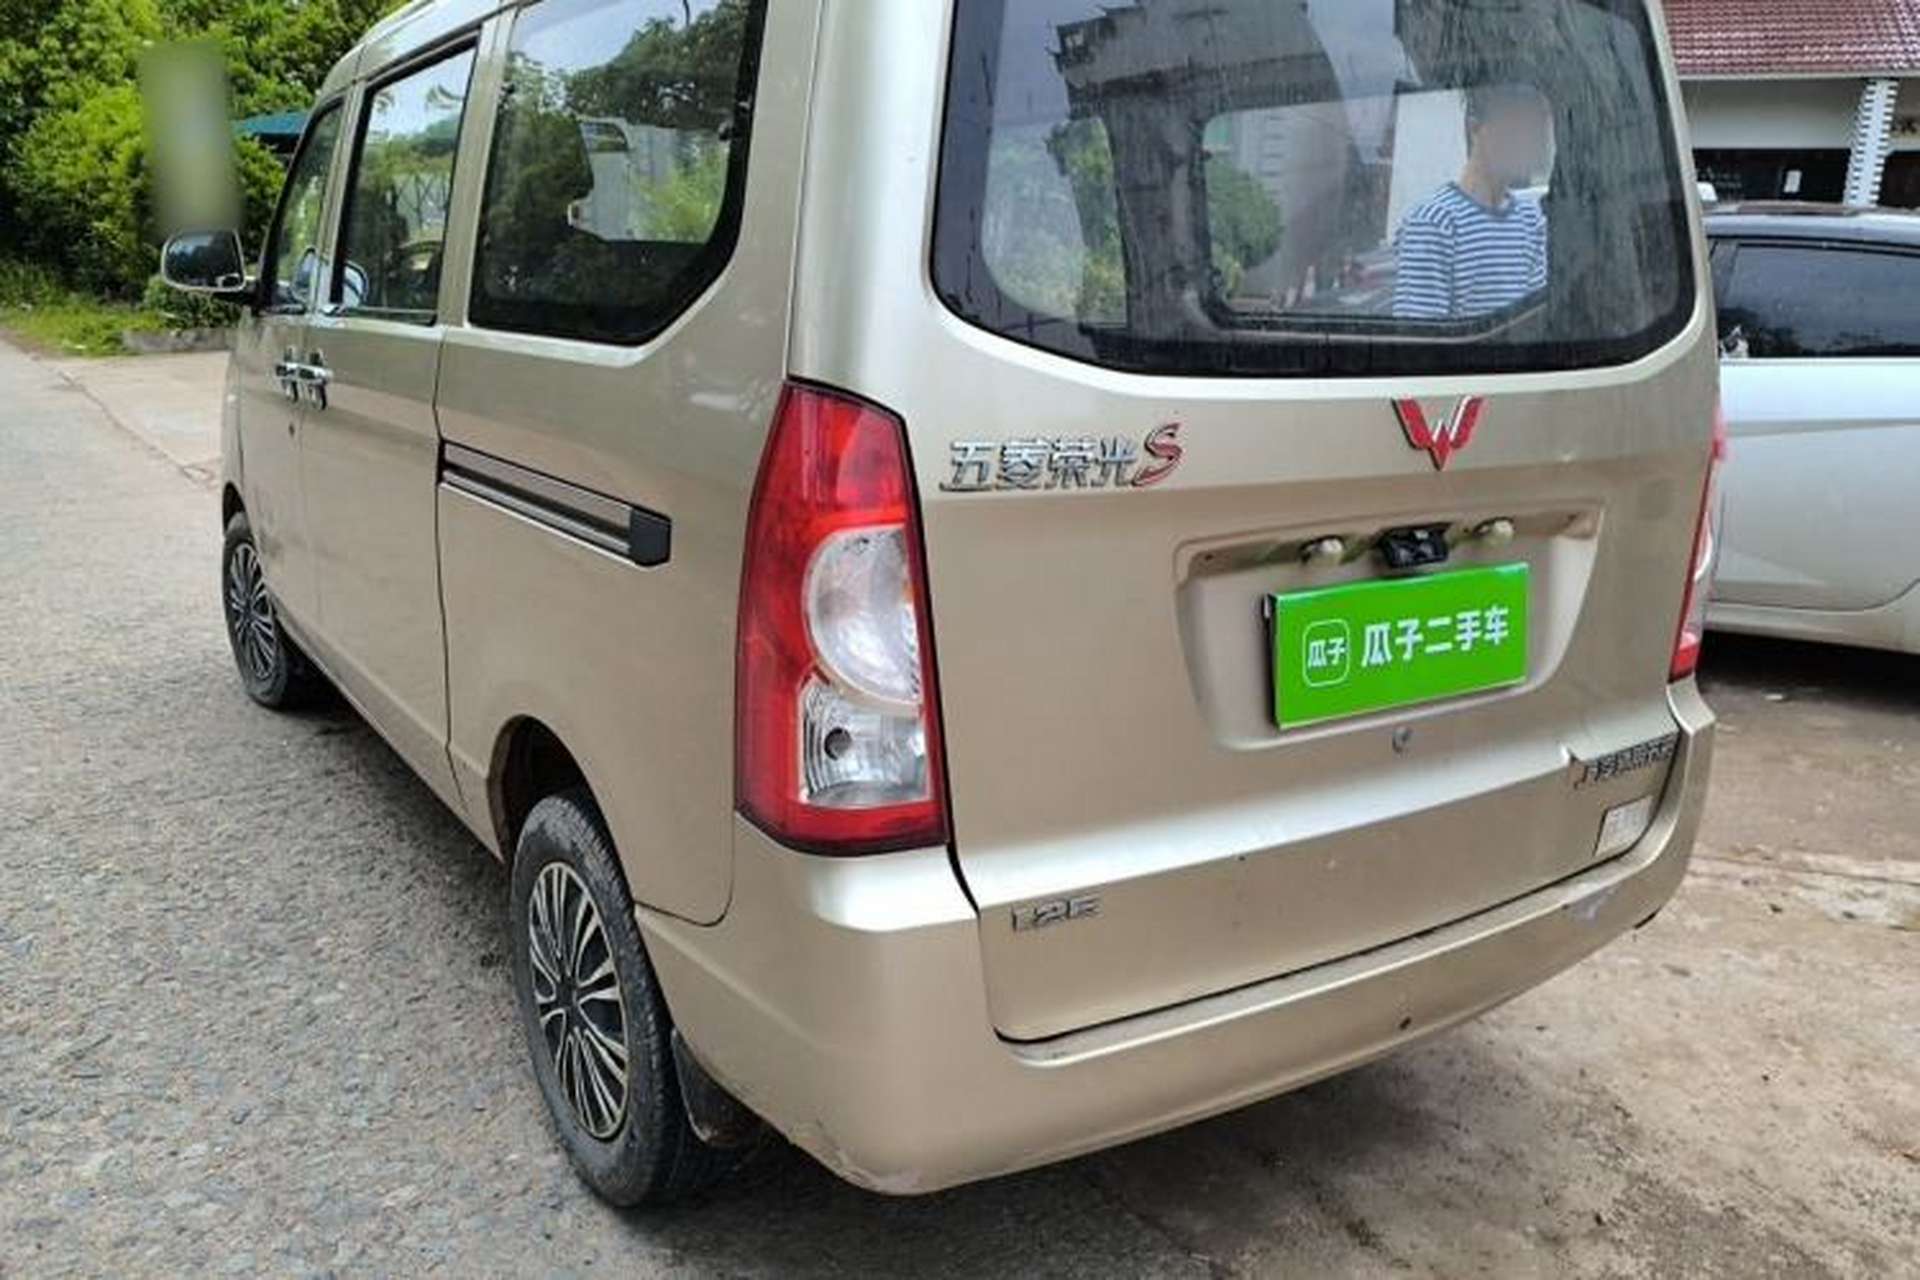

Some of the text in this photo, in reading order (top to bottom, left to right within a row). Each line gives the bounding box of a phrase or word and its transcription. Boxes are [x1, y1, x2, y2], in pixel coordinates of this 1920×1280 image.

[1307, 637, 1348, 668] 瓜子
[1361, 604, 1509, 667] 瓜子二手车
